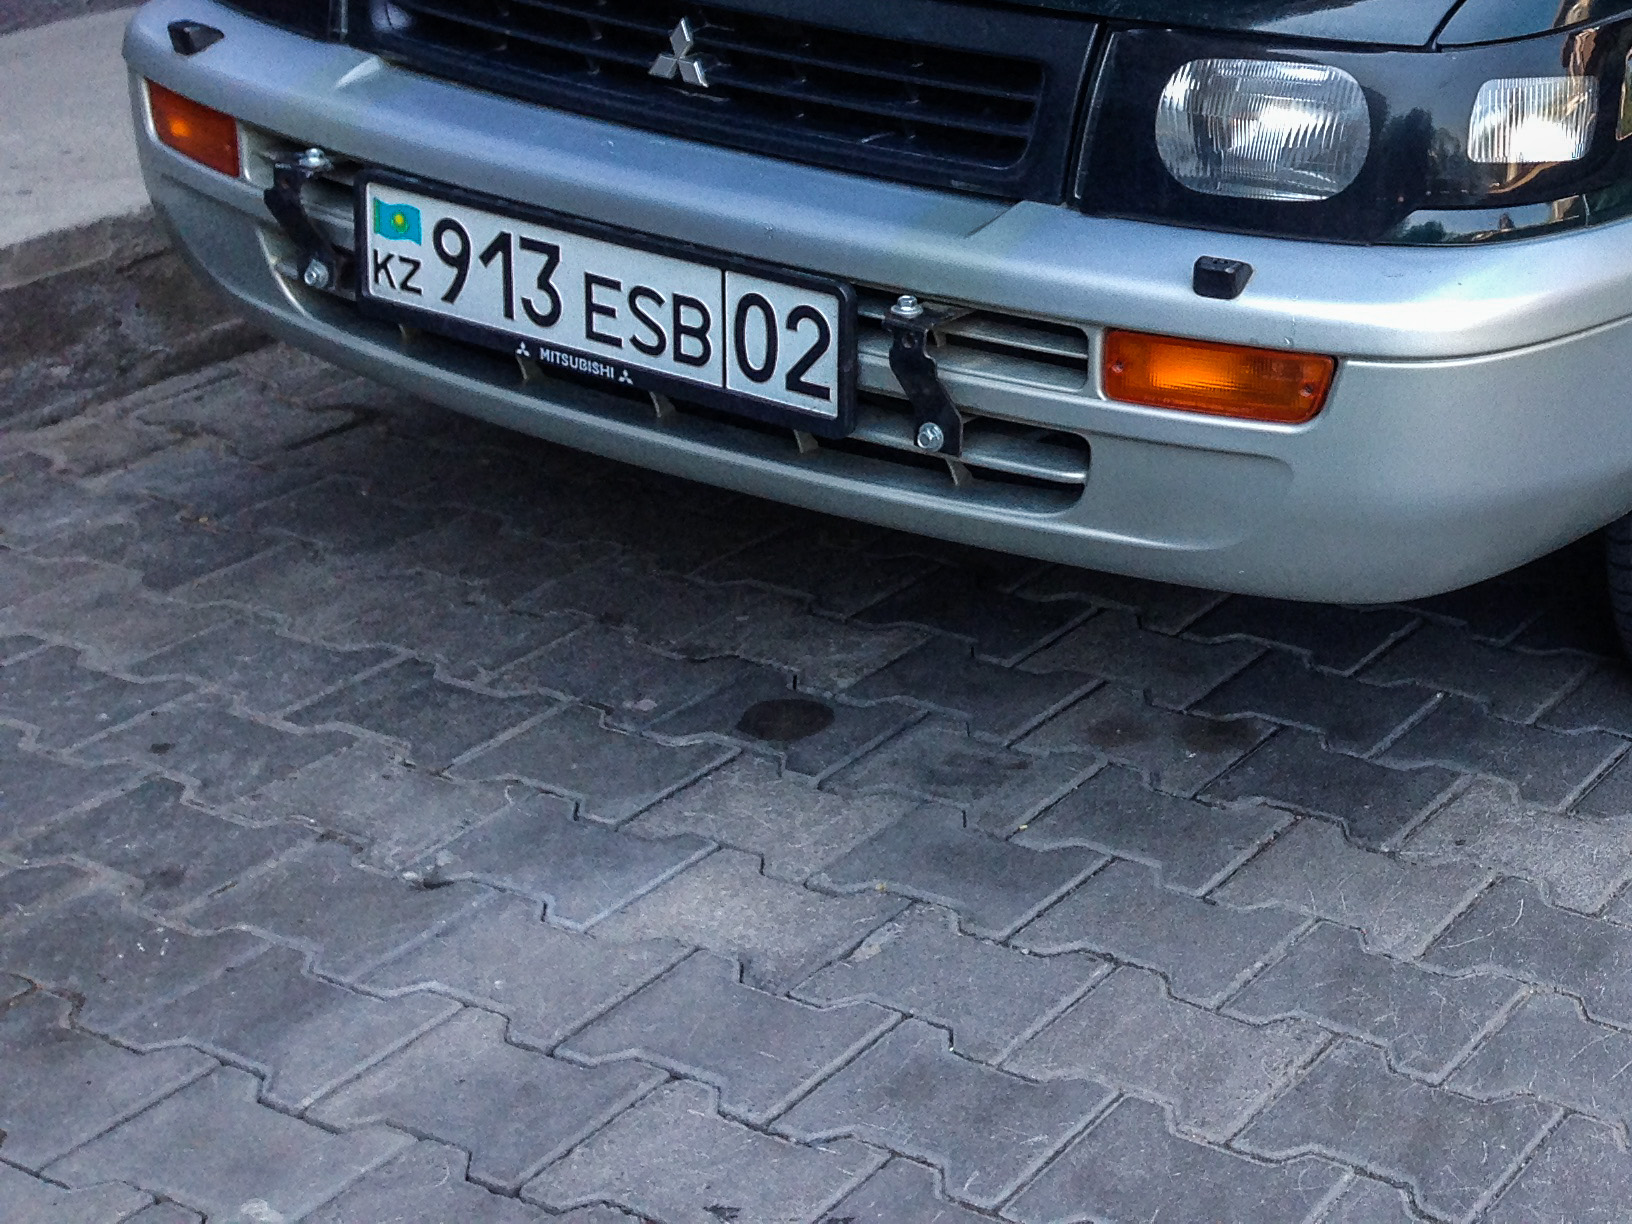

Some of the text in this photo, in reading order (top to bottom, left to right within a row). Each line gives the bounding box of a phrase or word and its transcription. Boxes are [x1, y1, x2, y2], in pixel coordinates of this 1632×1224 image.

[373, 248, 423, 295] KZ
[433, 217, 832, 401] 913 ESB 02
[540, 347, 614, 379] MITSUBISHI
